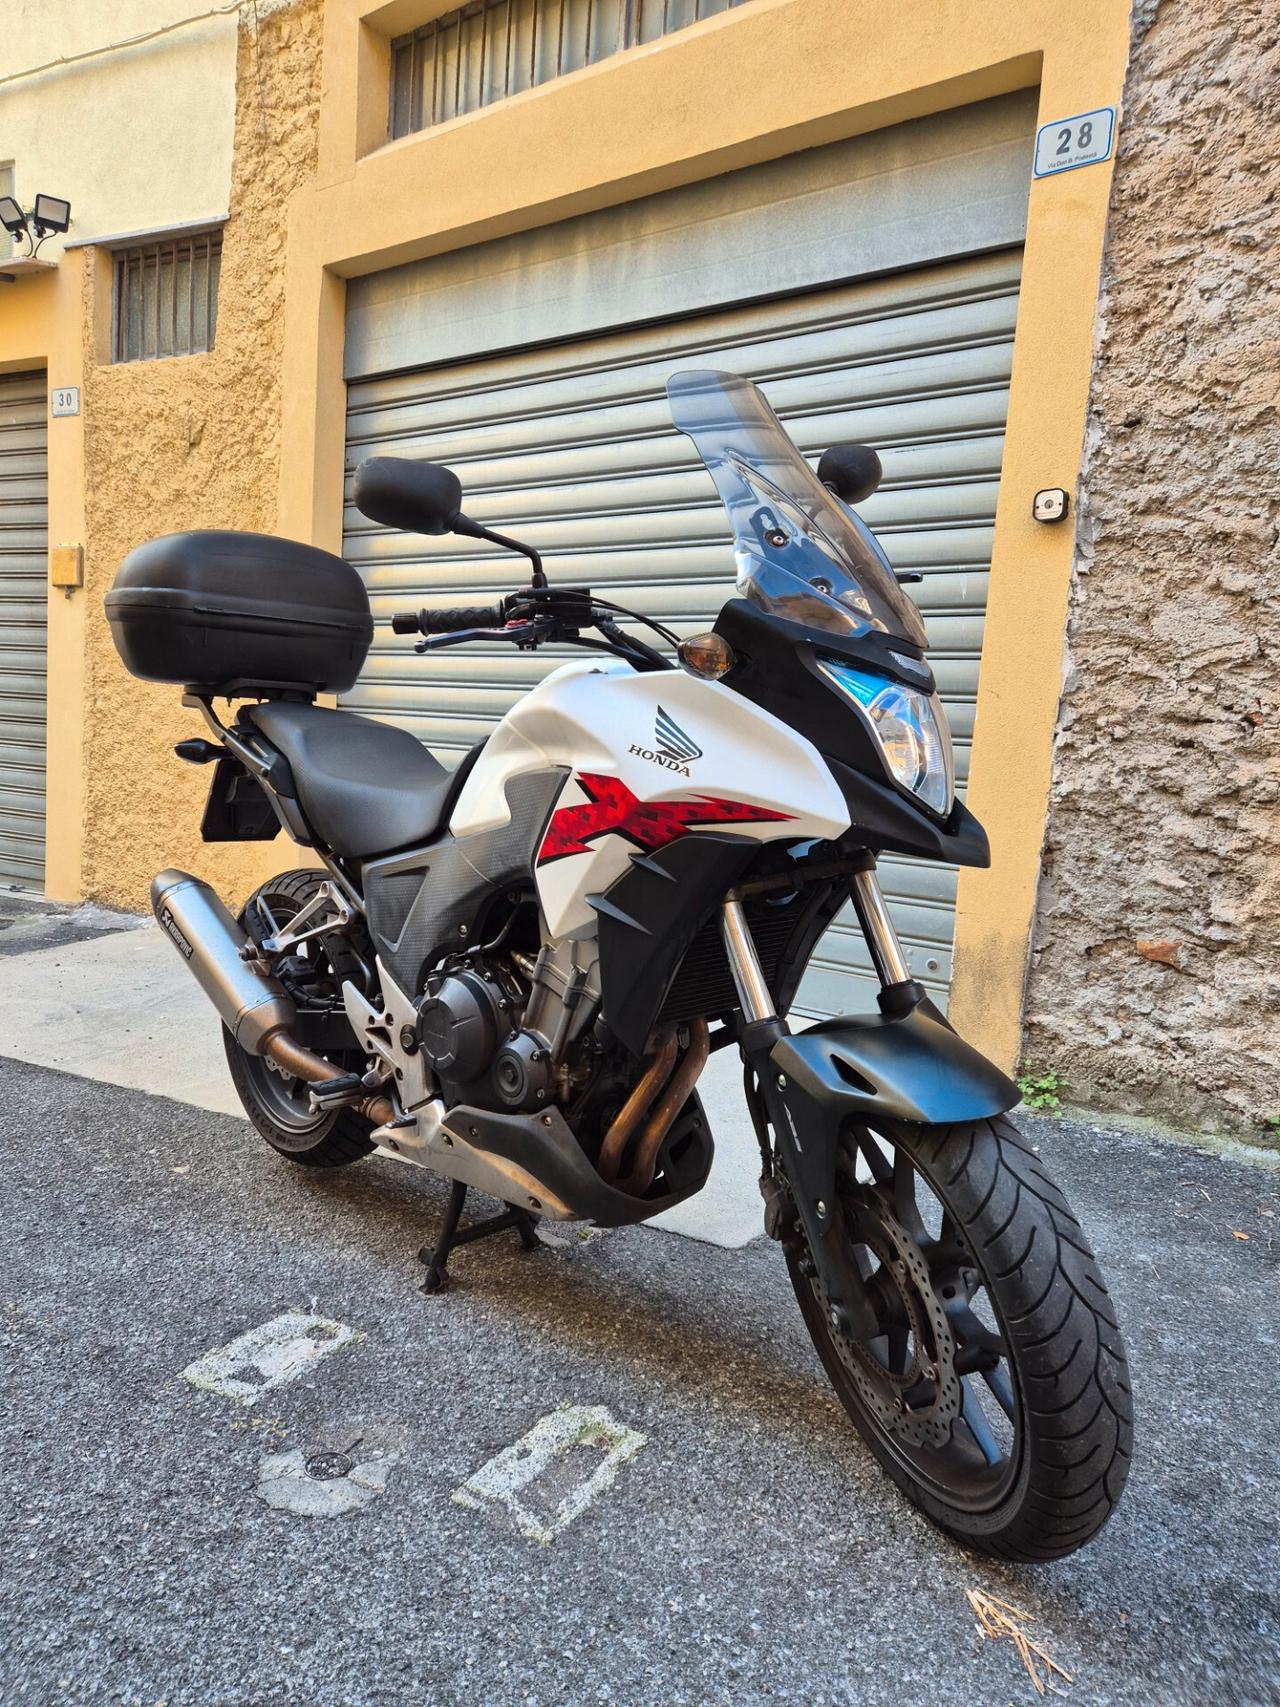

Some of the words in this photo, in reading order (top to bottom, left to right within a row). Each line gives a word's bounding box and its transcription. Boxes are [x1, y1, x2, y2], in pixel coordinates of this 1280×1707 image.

[1055, 121, 1093, 156] 28
[58, 393, 72, 407] 30
[628, 744, 691, 778] HONDA
